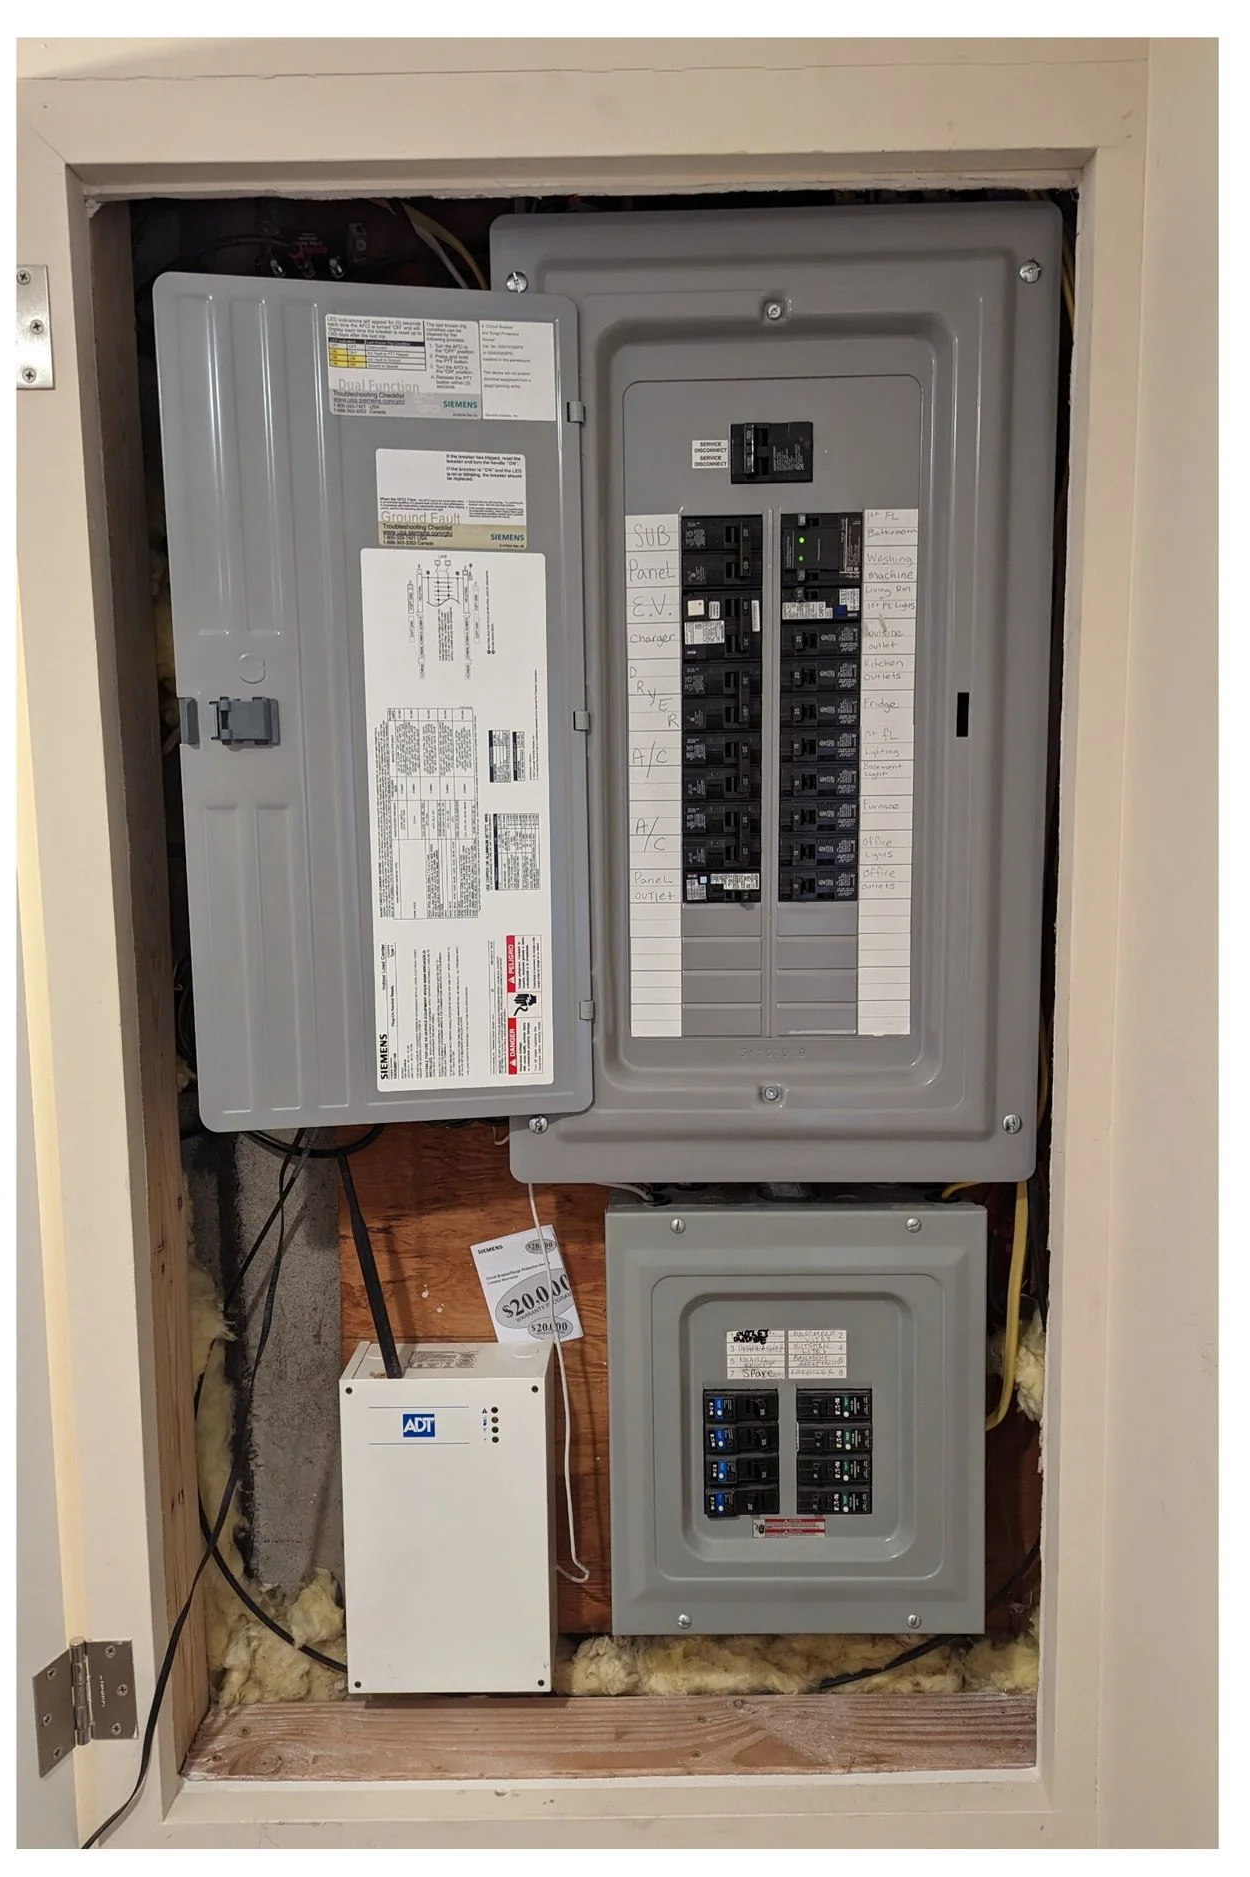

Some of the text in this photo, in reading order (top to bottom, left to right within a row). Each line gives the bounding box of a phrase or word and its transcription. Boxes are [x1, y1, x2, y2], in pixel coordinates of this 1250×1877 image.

[338, 378, 420, 393] Dual Function
[443, 400, 478, 409] SIEMENS
[381, 511, 460, 525] Ground Fault
[383, 523, 453, 532] Troubleshooting Checklist
[490, 533, 525, 542] SIEMENS
[633, 523, 671, 548] SUB
[867, 552, 913, 567] Washing
[863, 697, 900, 714] Fridge
[379, 1034, 389, 1080] SIEMENS
[477, 1244, 504, 1255] SIEMENS
[515, 1304, 545, 1323] WARRANTY
[403, 1416, 435, 1433] ADT
